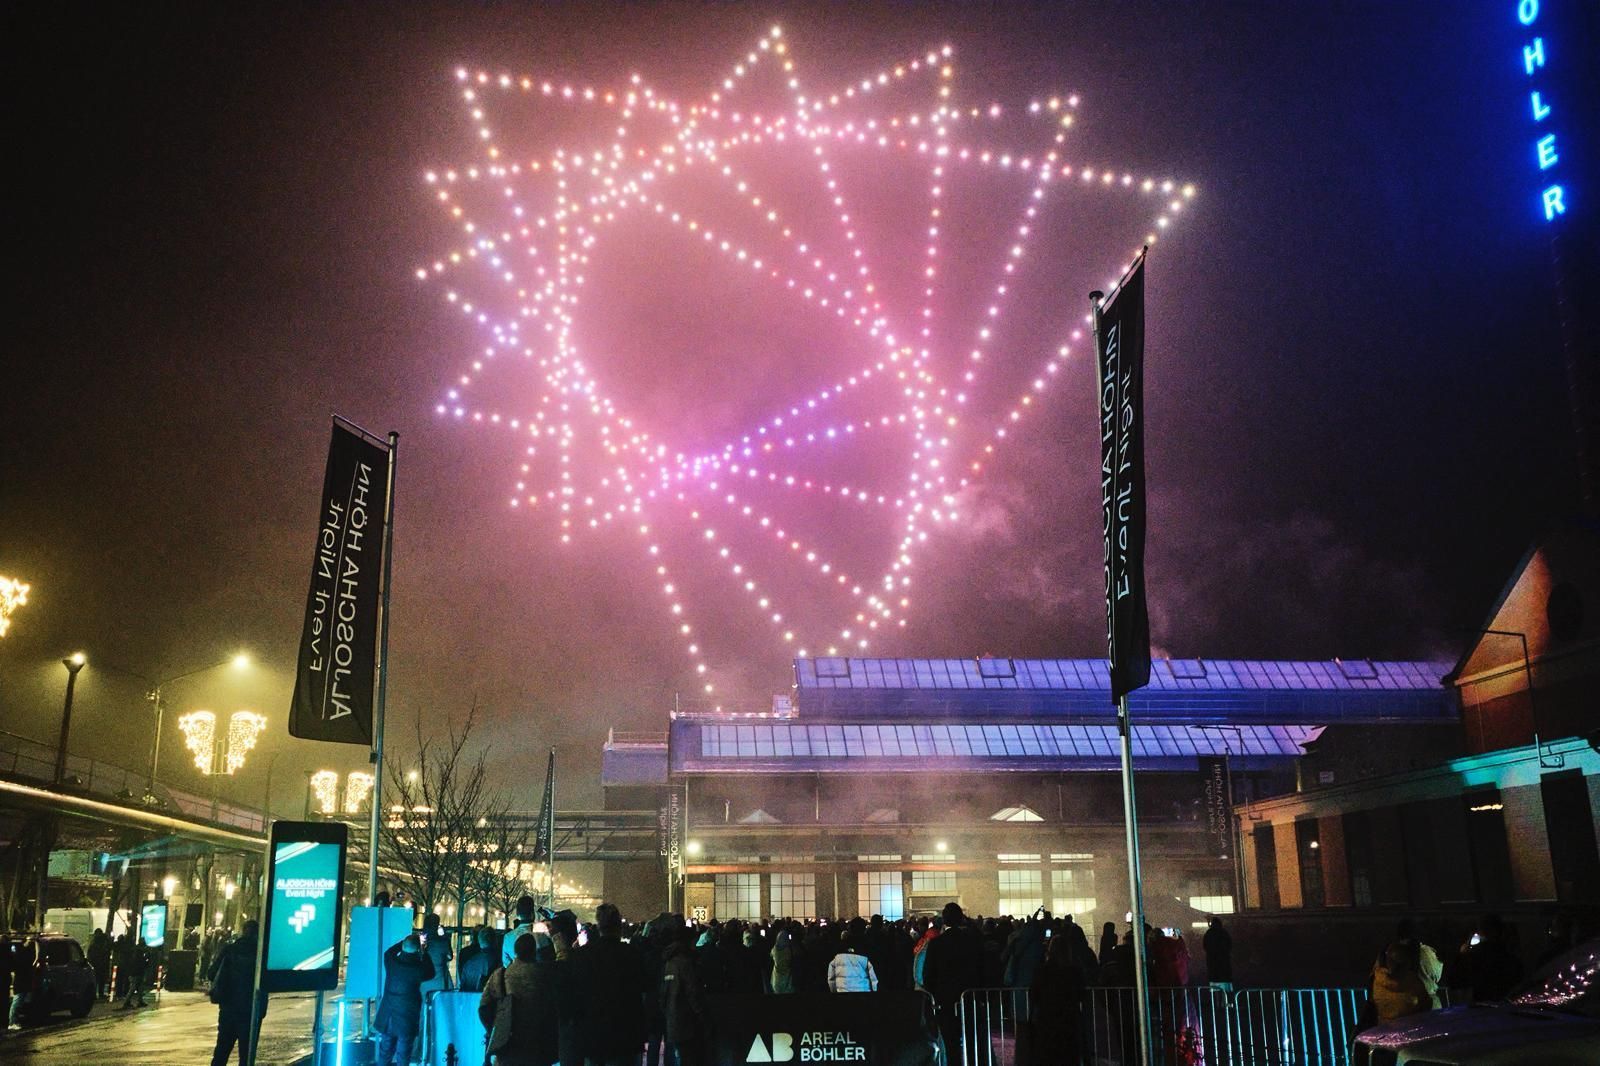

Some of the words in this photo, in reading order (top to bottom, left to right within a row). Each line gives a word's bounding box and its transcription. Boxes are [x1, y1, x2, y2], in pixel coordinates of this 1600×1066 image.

[1101, 324, 1117, 443] HÖHN
[1119, 364, 1133, 475] Night
[1117, 482, 1132, 600] Event
[694, 909, 706, 921] 33
[801, 1032, 856, 1045] AREAL
[801, 1045, 866, 1061] BÖHLER
